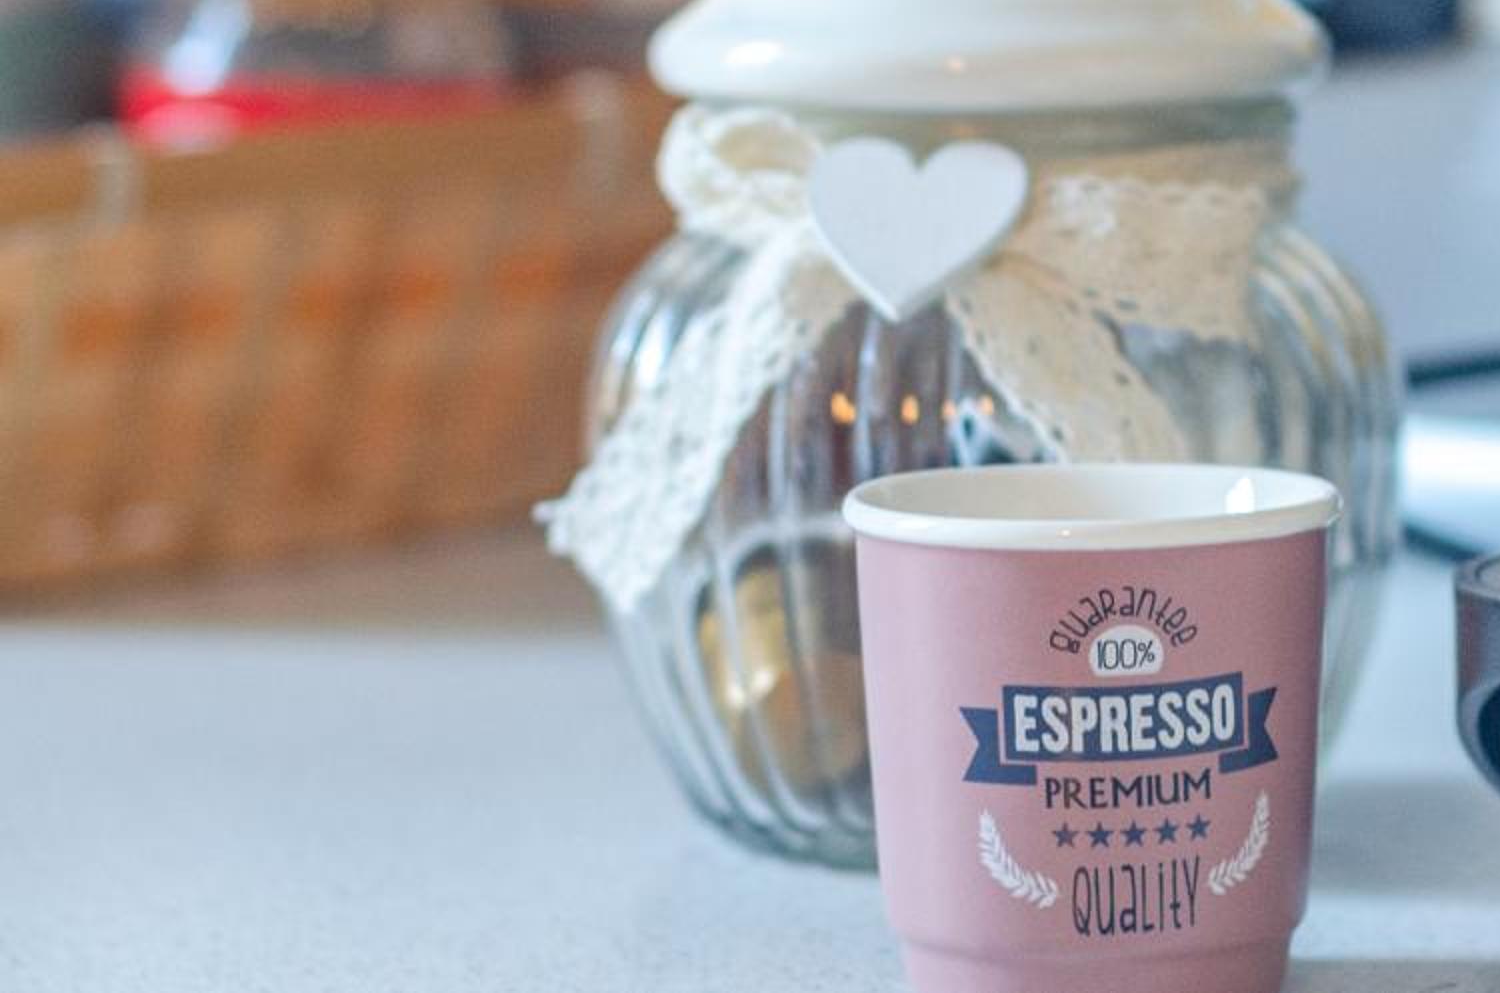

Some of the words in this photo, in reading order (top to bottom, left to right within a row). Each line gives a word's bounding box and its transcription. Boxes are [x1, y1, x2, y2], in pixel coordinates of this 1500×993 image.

[1097, 638, 1155, 670] 100%
[1013, 683, 1236, 753] ESPRESSO
[1044, 768, 1212, 809] PREMIUM
